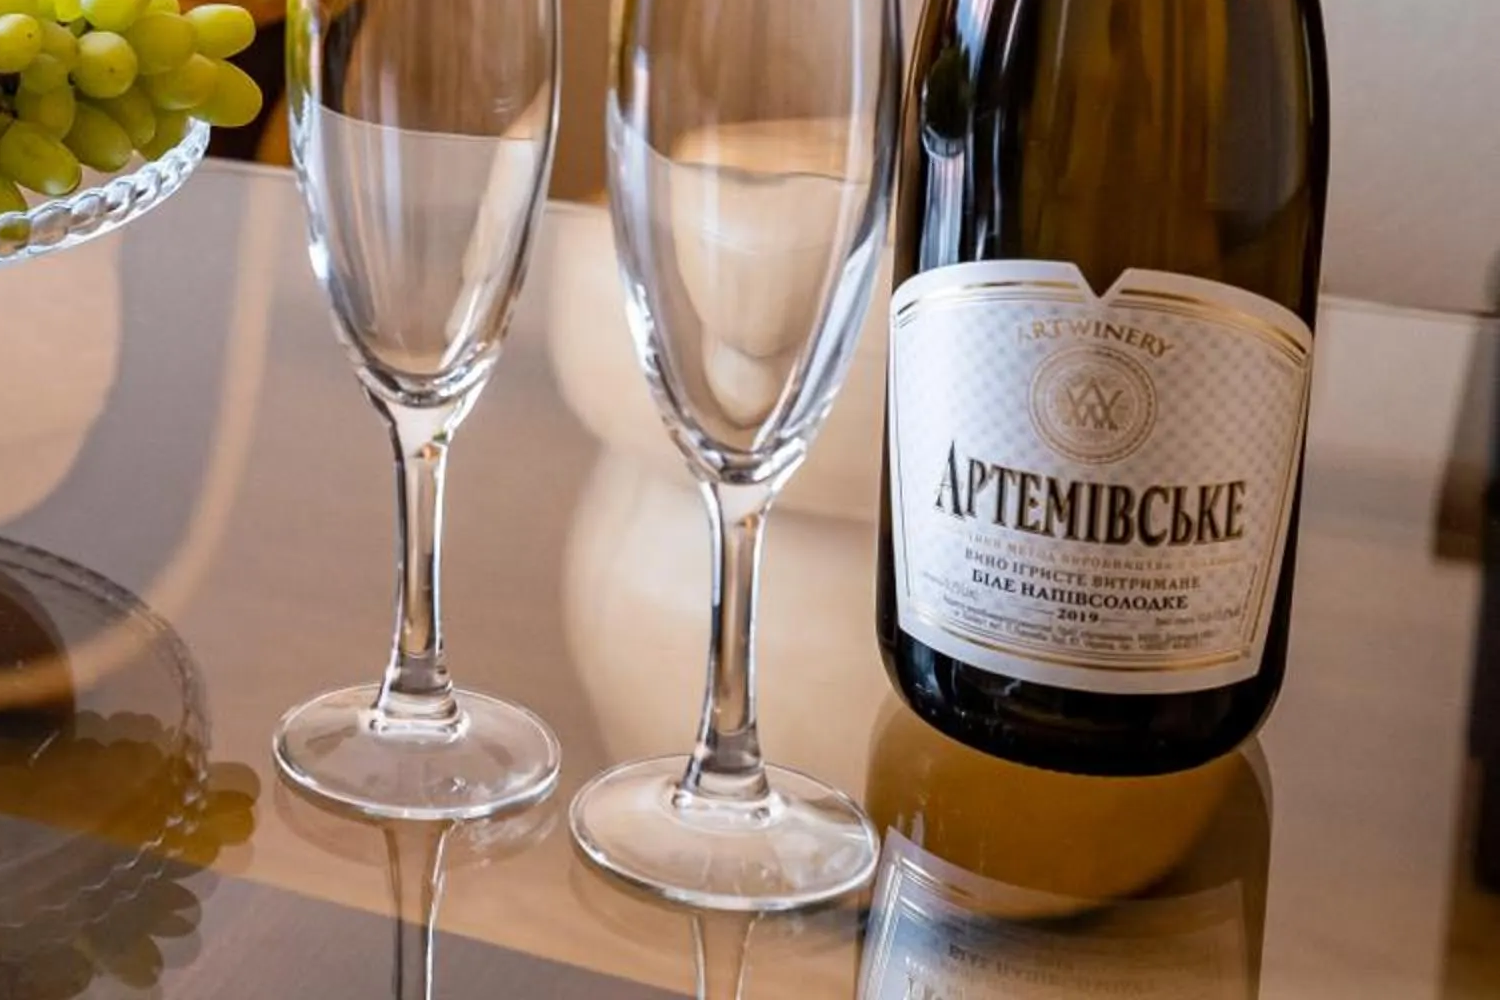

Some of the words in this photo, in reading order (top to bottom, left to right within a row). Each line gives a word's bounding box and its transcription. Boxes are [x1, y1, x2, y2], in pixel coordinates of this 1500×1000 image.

[1016, 318, 1176, 359] ARTWINERY
[934, 438, 1246, 548] АРТЕМІВСЬКЕ
[965, 547, 1008, 571] ВИНО
[1012, 562, 1087, 587] ІГРИСТЕ
[1091, 574, 1202, 591] ВИТРИМАНЕ
[972, 567, 1017, 593] БІЛЕ
[1021, 580, 1189, 613] НАПІВСОЛОДКЕ
[1057, 607, 1099, 623] 2019
